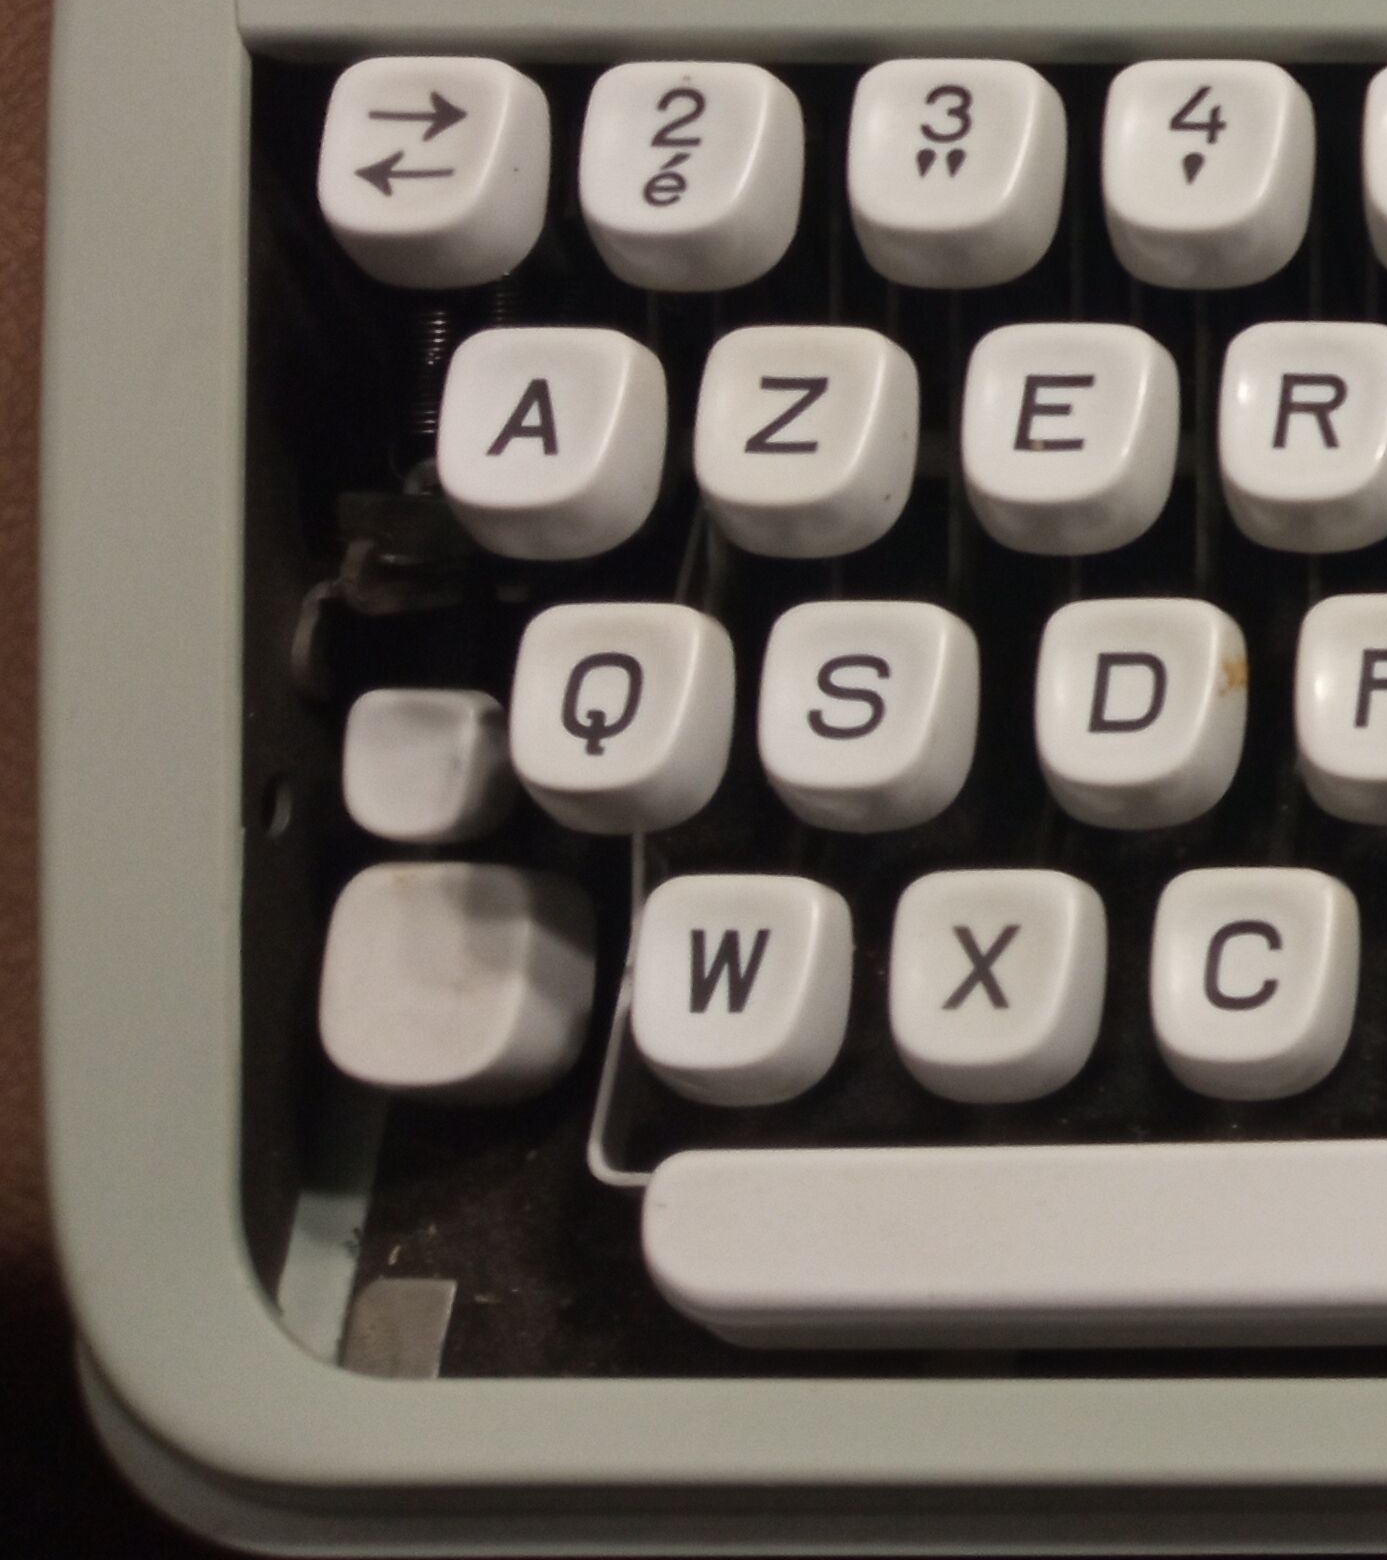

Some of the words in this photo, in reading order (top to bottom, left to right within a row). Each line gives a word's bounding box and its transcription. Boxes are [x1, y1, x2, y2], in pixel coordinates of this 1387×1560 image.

[650, 88, 707, 148] 2
[919, 84, 974, 142] 3
[1169, 86, 1228, 144] 4
[642, 152, 692, 208] é
[486, 378, 559, 456] A
[744, 376, 829, 454] Z
[1013, 374, 1096, 451] E
[1272, 373, 1348, 449] R
[561, 652, 644, 756] Q
[806, 654, 891, 740] S
[1088, 651, 1168, 734] D
[688, 928, 770, 1014] W
[941, 924, 1022, 1011] X
[1203, 920, 1283, 1011] C
